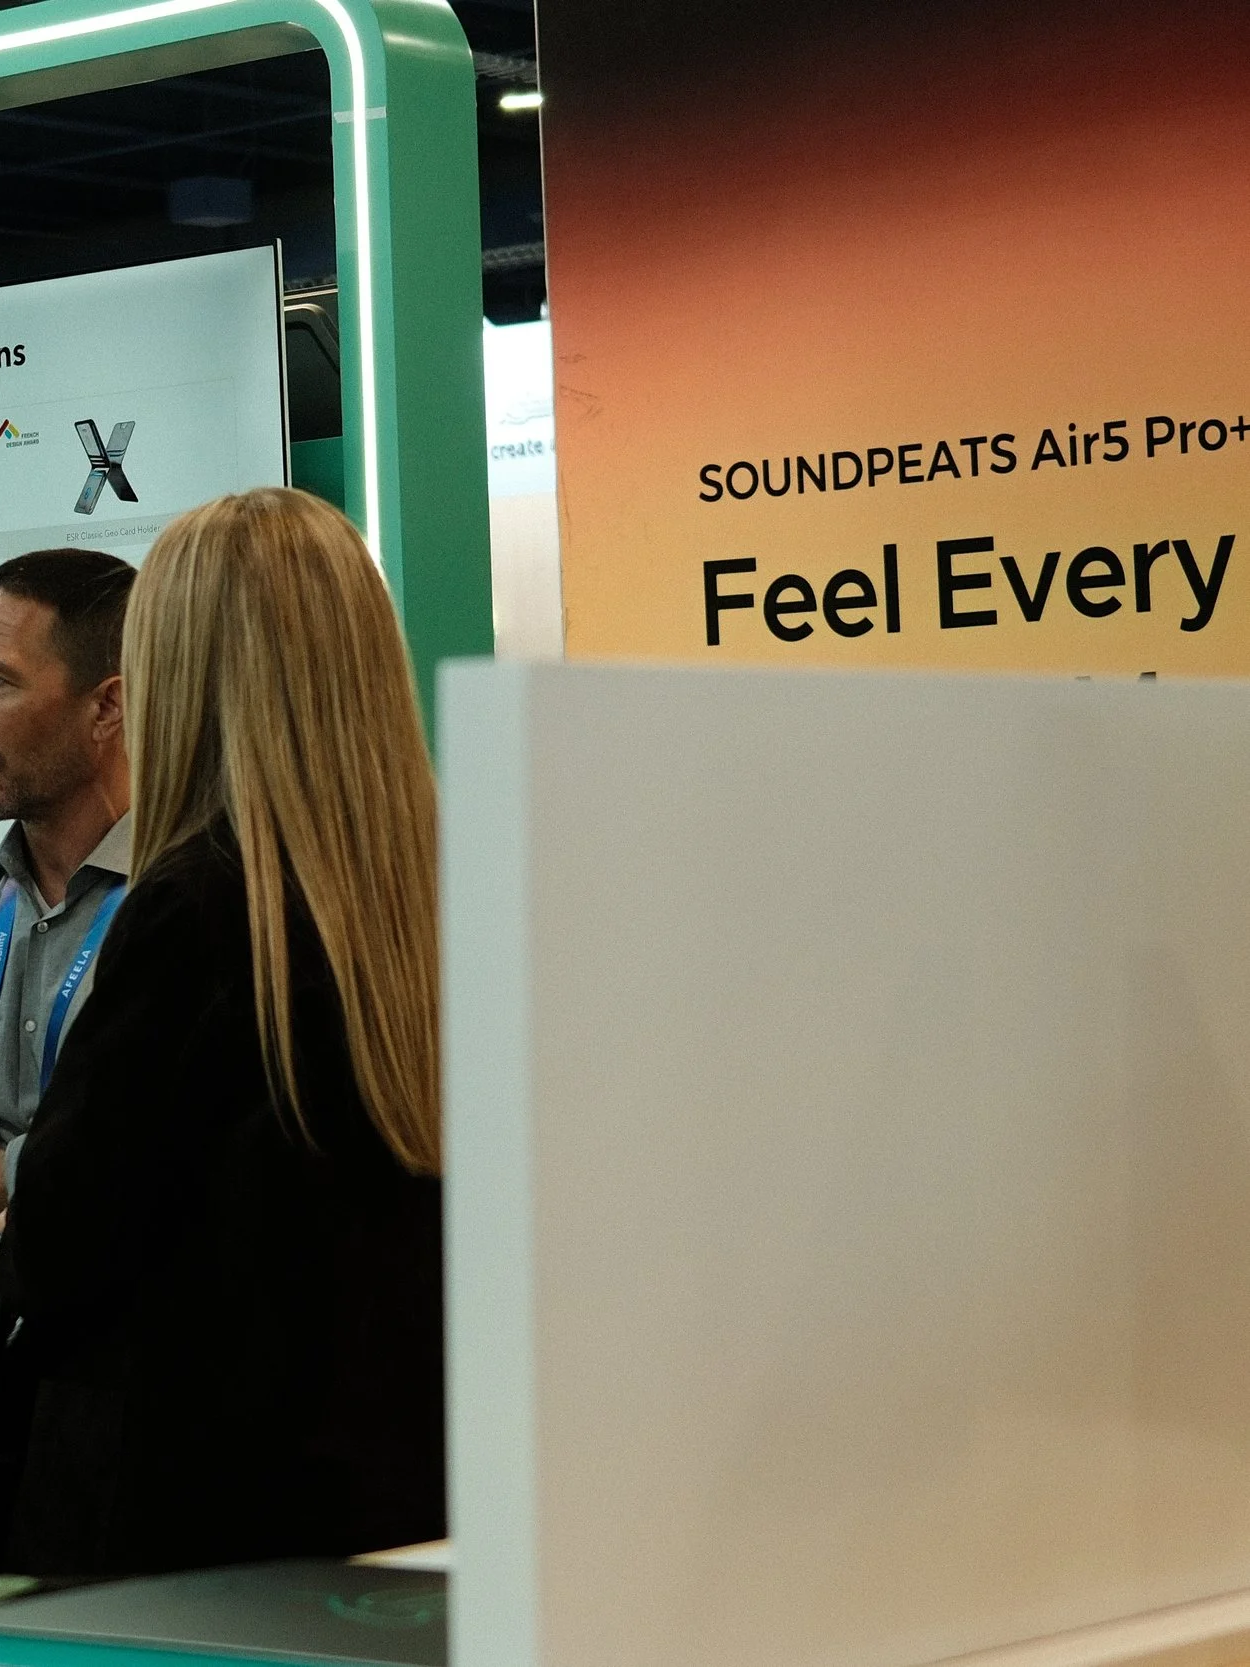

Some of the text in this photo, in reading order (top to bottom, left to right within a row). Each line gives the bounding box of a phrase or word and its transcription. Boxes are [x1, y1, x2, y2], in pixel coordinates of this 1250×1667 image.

[491, 440, 544, 460] create
[698, 415, 1250, 503] SOUNDPEATS Air5 Pro+
[66, 524, 161, 541] ESR Classic Geo Card Holder
[703, 534, 1236, 646] Feel Every
[62, 950, 92, 998] AFEELA
